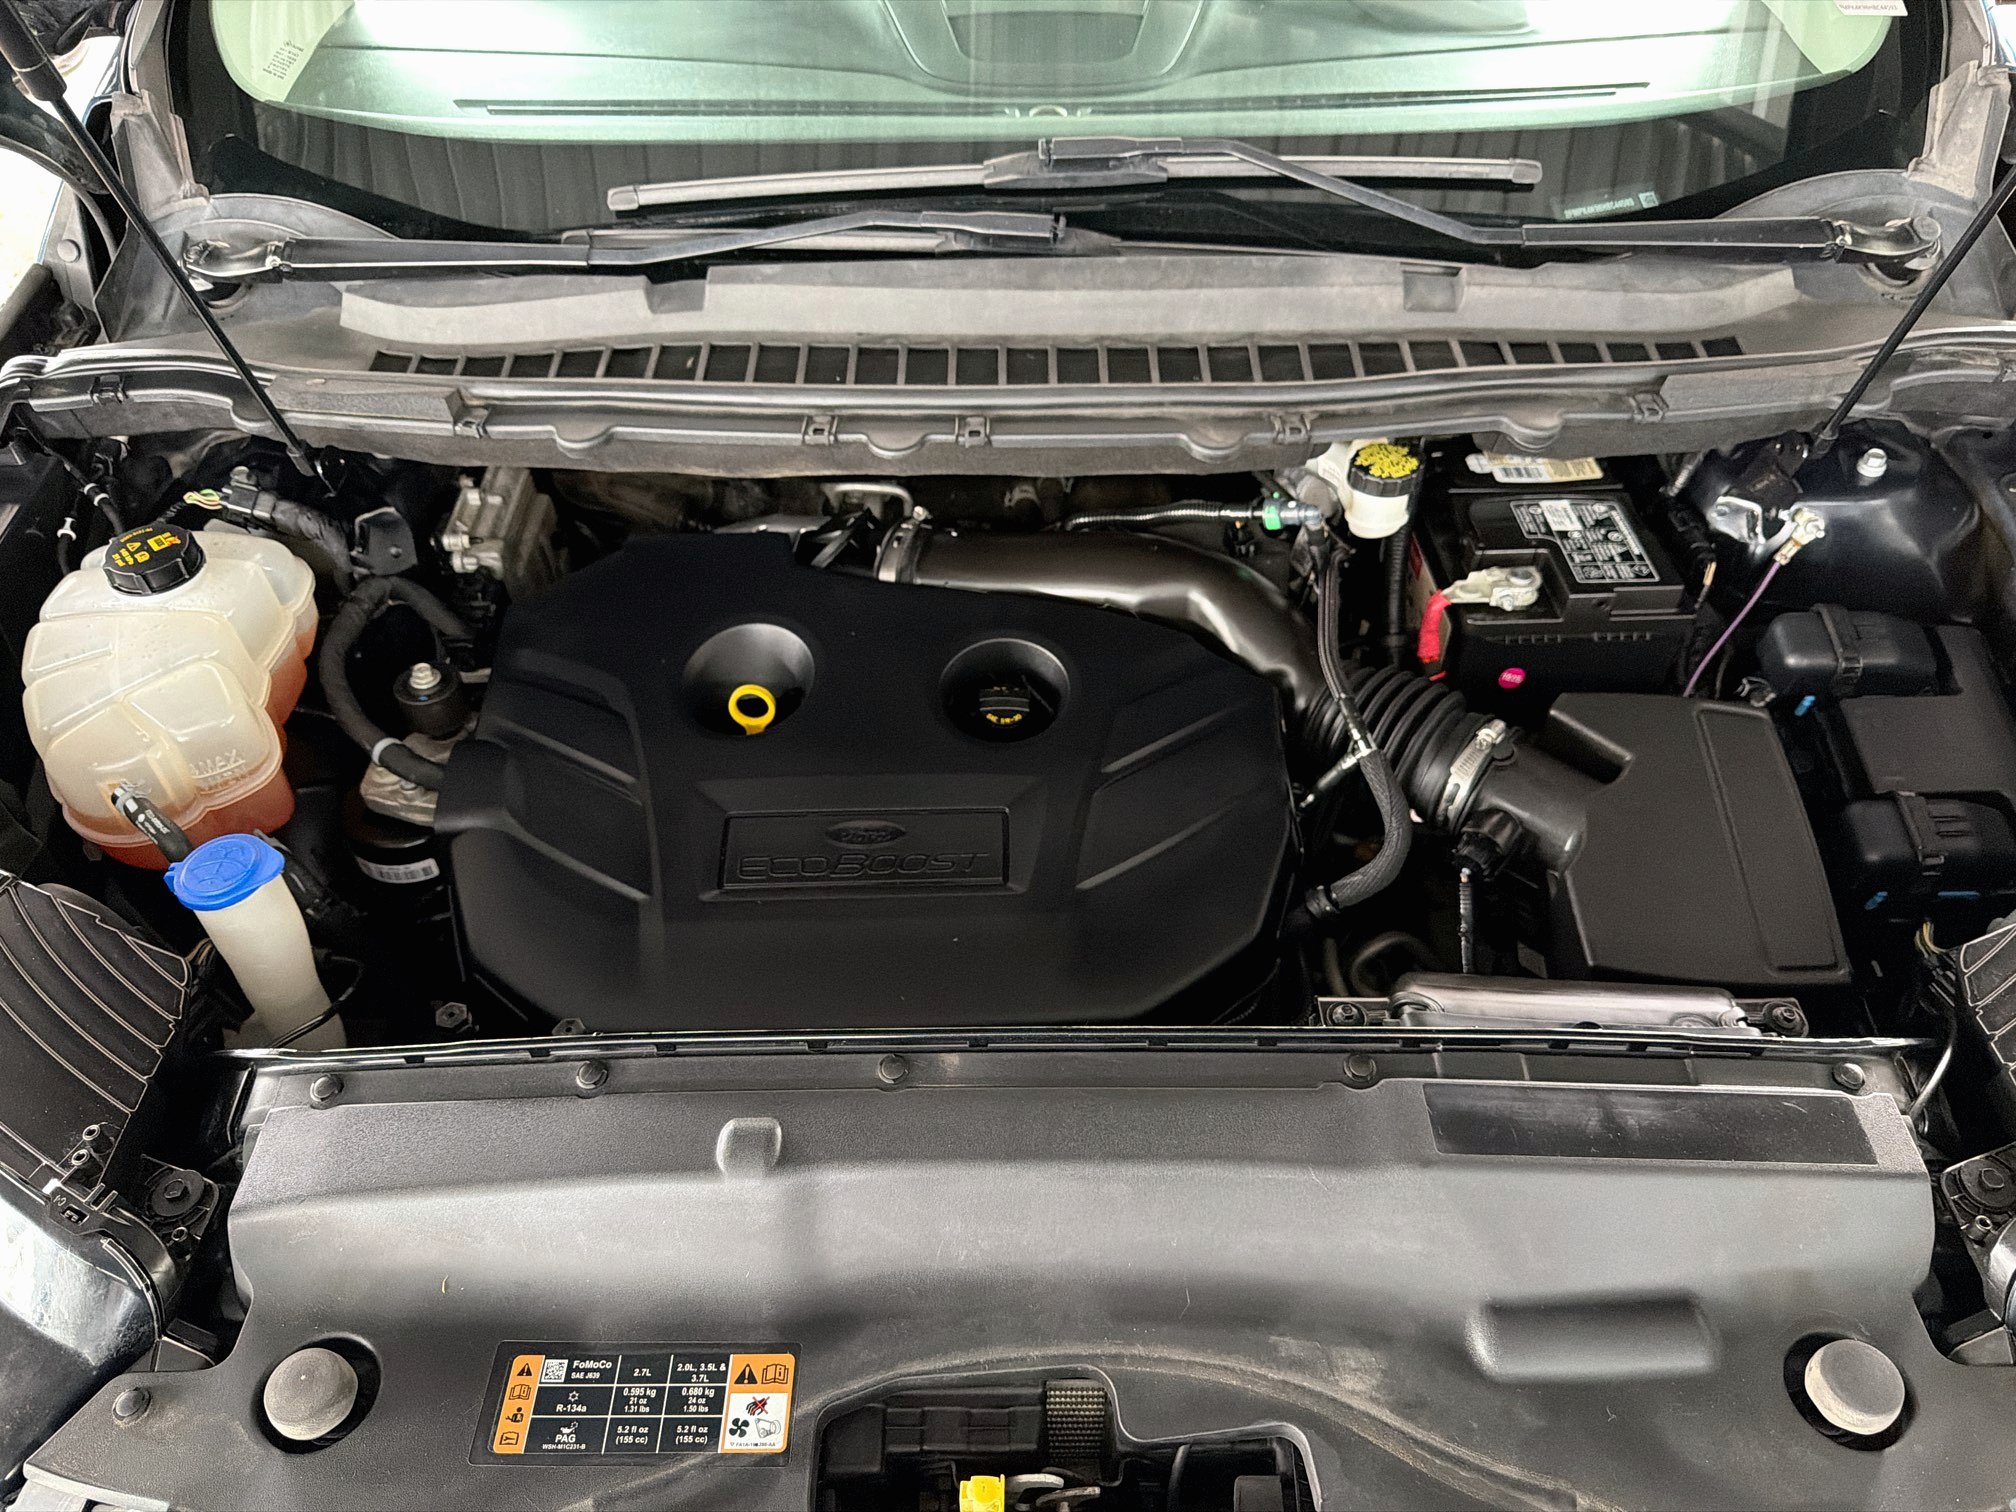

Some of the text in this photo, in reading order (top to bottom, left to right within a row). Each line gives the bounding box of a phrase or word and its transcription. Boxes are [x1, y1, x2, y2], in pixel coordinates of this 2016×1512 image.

[573, 1360, 612, 1369] FoMoCo
[677, 1363, 727, 1372] 2.0L, 3.5L &
[633, 1369, 652, 1377] 2.7L
[691, 1374, 709, 1383] 3.7L
[623, 1387, 657, 1397] 0.595 kg
[681, 1387, 715, 1397] 0.680 kg
[556, 1404, 587, 1413] R-134a
[624, 1405, 650, 1413] 1.31 lbs
[683, 1405, 709, 1413] 1.50 lbs
[631, 1425, 638, 1433] fl
[691, 1425, 698, 1433] fl
[555, 1434, 576, 1443] PAG
[615, 1435, 648, 1445] (155 cc)
[675, 1435, 708, 1444] (155 cc)
